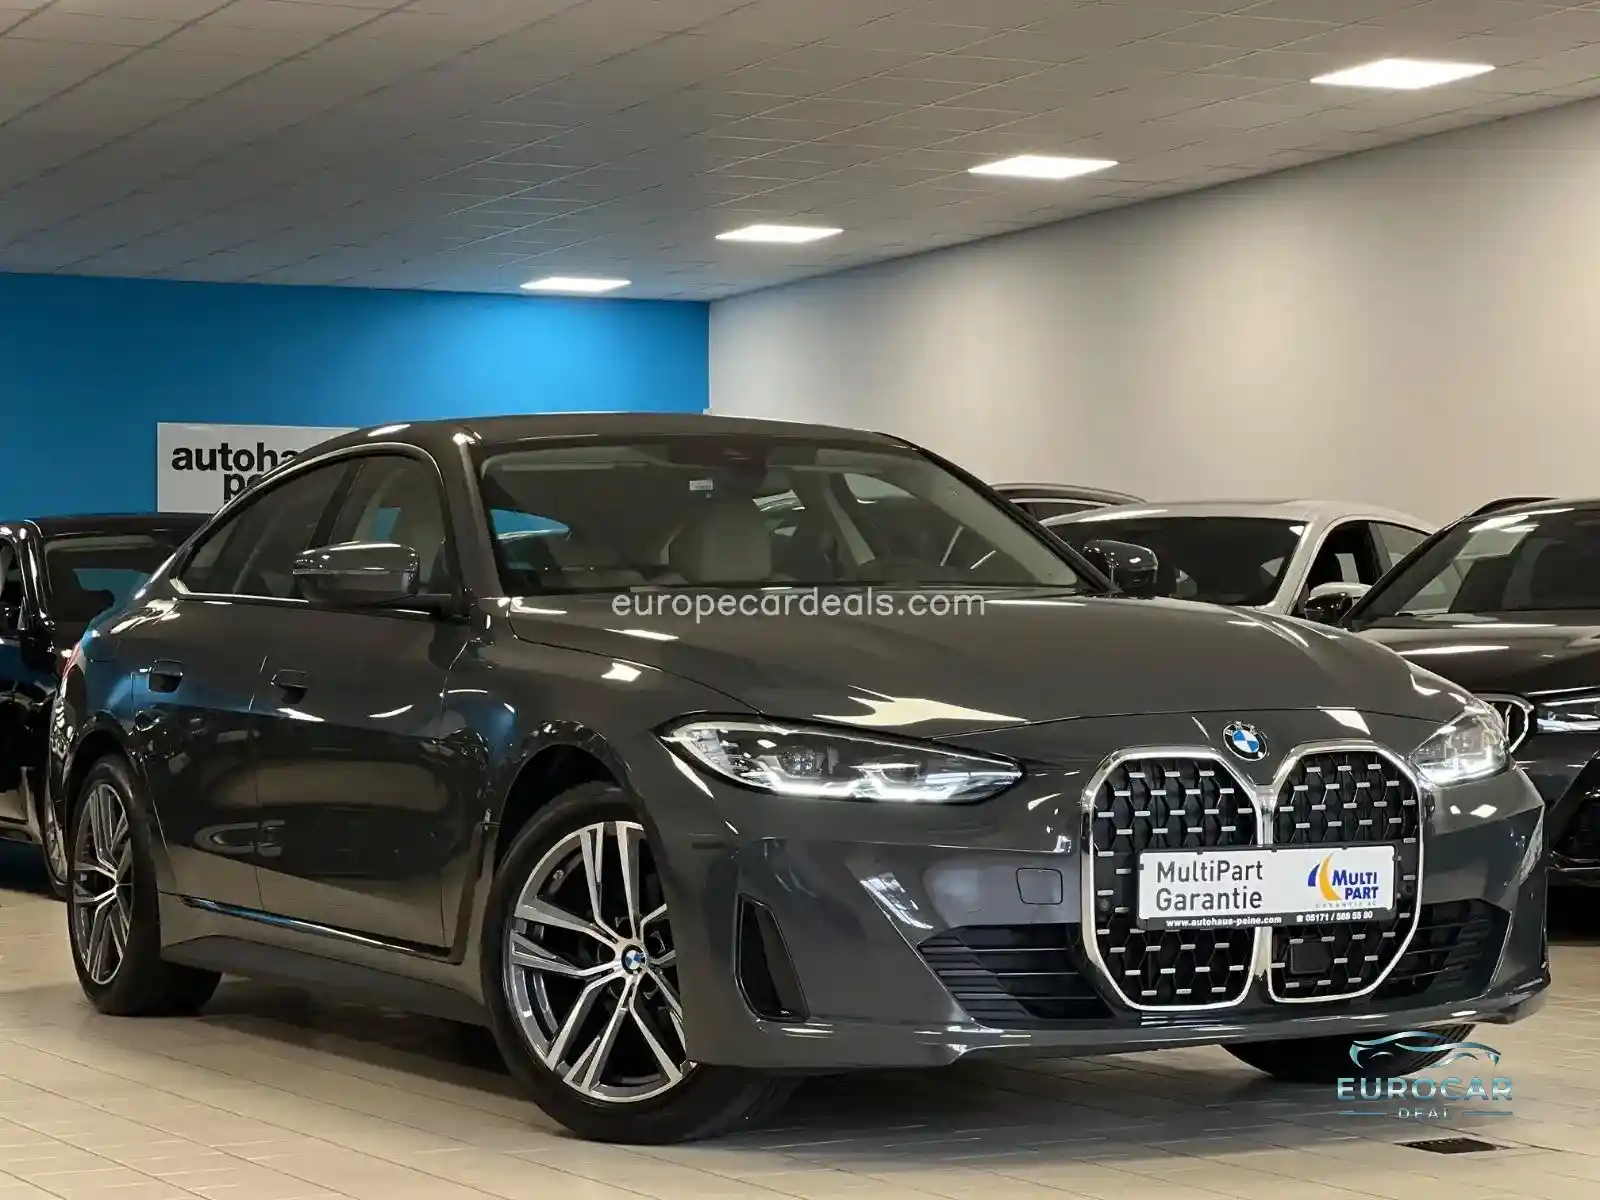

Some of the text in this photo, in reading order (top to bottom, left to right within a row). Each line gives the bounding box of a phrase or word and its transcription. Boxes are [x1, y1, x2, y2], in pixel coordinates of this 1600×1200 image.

[1157, 860, 1263, 883] MultiPart
[1332, 869, 1378, 886] MULTI
[1156, 886, 1263, 911] Garantie
[1344, 887, 1379, 900] PART
[1166, 916, 1282, 927] www.autohaus-peine.com
[1305, 912, 1329, 922] 05171
